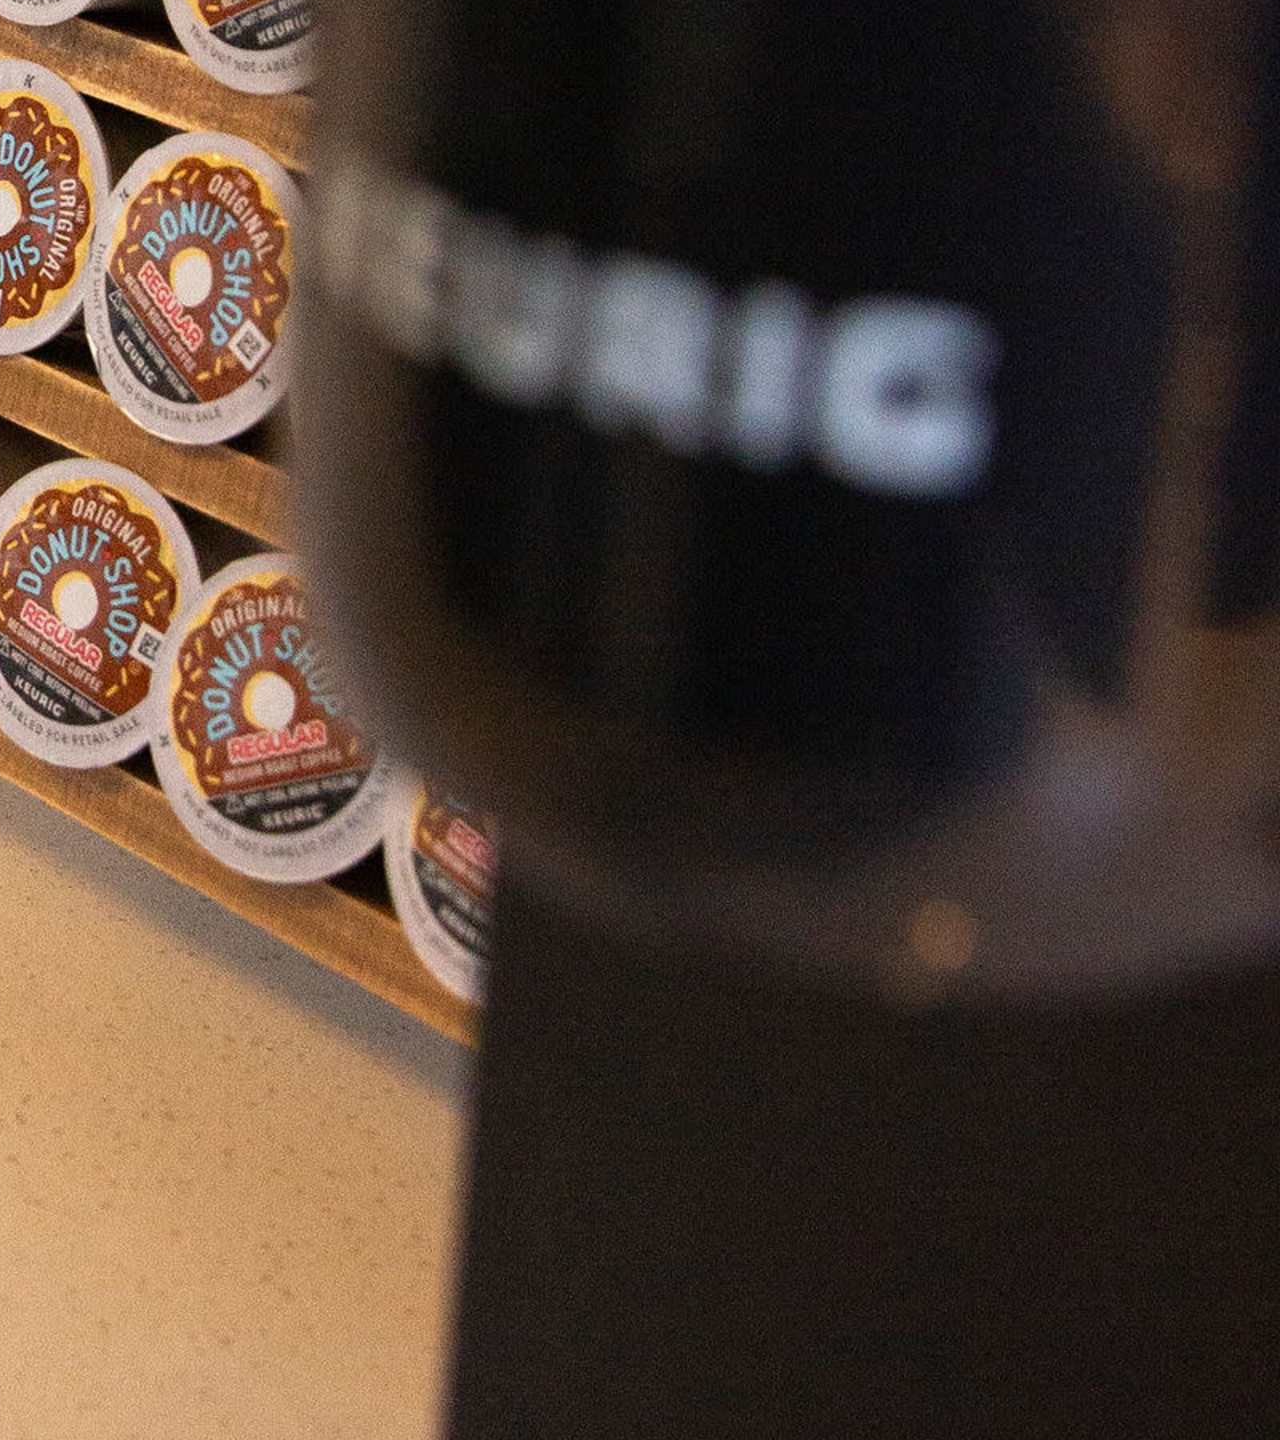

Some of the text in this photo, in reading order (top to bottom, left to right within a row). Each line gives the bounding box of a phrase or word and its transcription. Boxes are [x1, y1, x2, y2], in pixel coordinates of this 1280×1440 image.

[256, 12, 312, 46] KEURIG
[0, 132, 58, 234] DONUT
[208, 173, 276, 263] ORIGINAL
[38, 177, 78, 282] ORIGINAL
[138, 259, 204, 353] REGULAR
[142, 200, 254, 348] DONUT SHOP
[117, 330, 157, 386] KEURIG
[314, 154, 1003, 498] URIG
[71, 496, 152, 566] ORIGINAL
[16, 524, 139, 659] DONUT SHOP
[210, 594, 308, 639] ORIGINAL
[20, 598, 103, 672] REGULAR
[67, 657, 105, 693] COFFEE
[13, 675, 64, 717] KEURIG
[201, 622, 265, 741] DONUT
[226, 719, 328, 766] REGULAR
